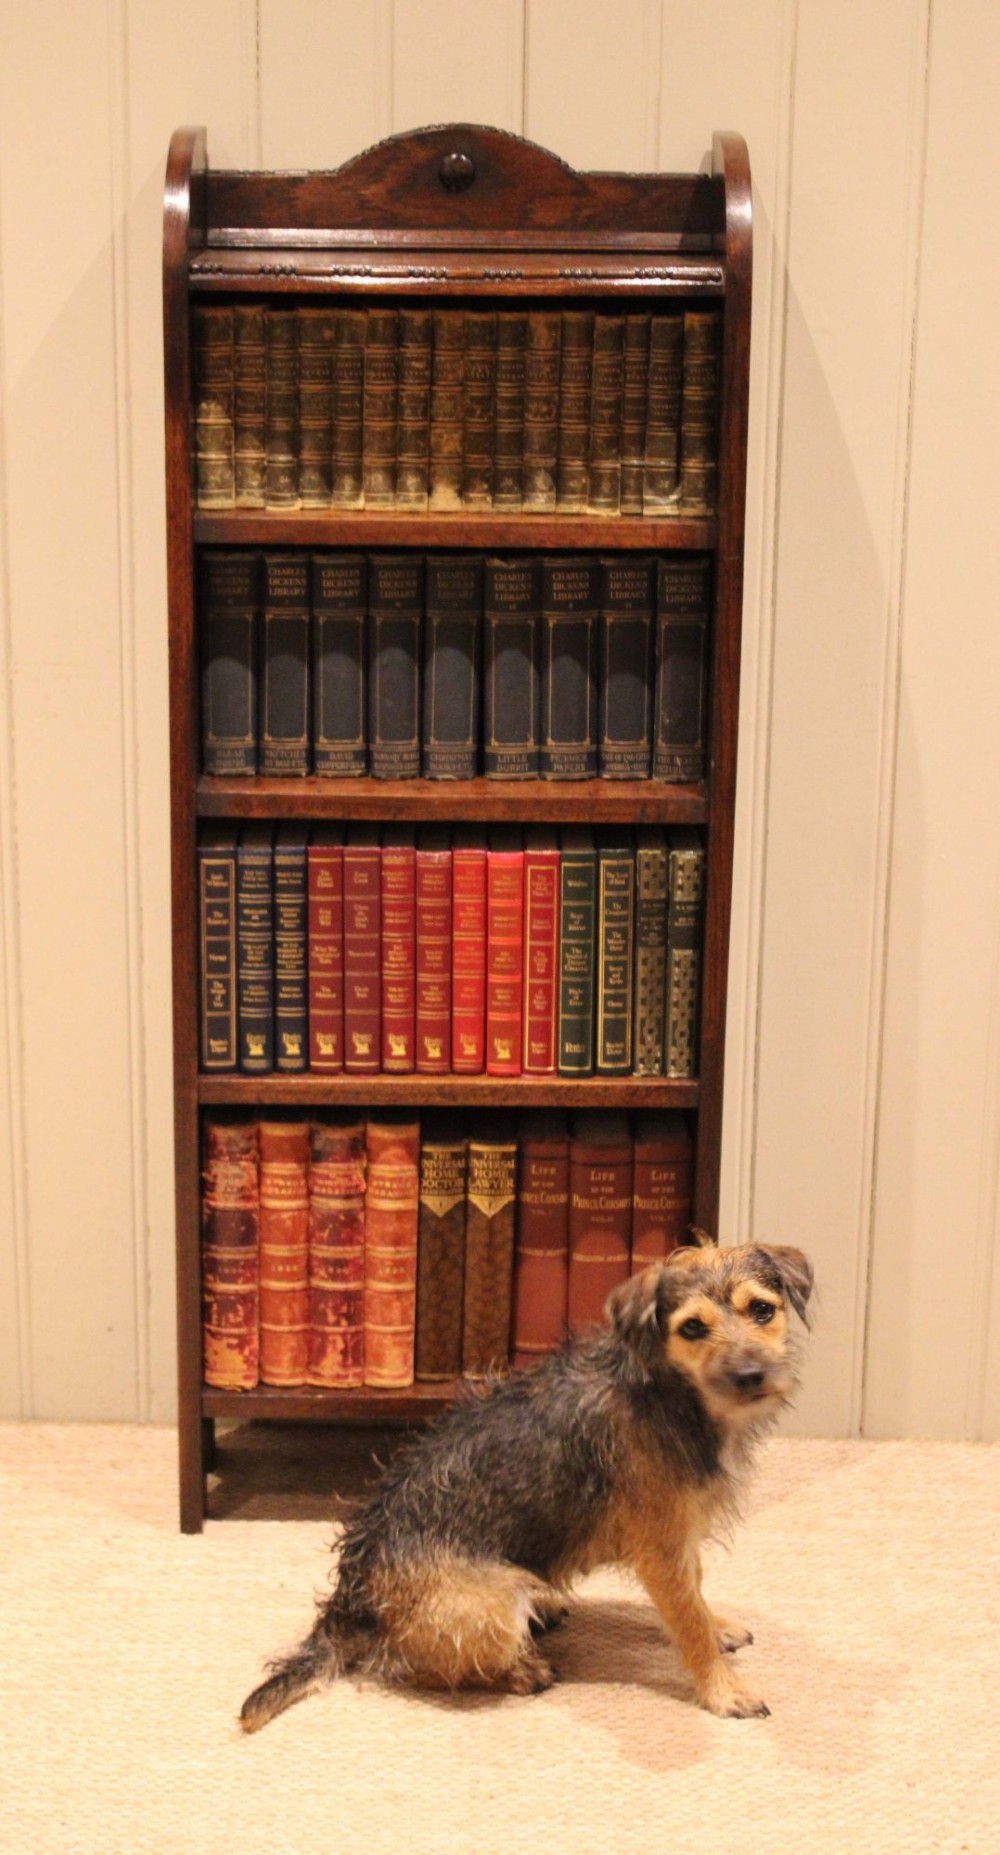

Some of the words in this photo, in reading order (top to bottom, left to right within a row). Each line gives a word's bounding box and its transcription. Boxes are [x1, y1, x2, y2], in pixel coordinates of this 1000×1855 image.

[268, 568, 306, 576] CHARLES
[321, 569, 360, 577] CHARLES
[493, 572, 532, 581] CHARLES
[552, 571, 590, 580] CHARLES
[609, 571, 648, 580] CHARLES
[269, 577, 306, 586] DICKENS
[322, 579, 361, 587] DICKENS
[552, 581, 590, 590] DICKENS
[609, 580, 648, 590] DICKENS
[494, 582, 532, 591] DICKENS
[269, 587, 304, 596] LIBRARY
[322, 589, 359, 598] LIBRARY
[553, 591, 588, 600] LIBRARY
[610, 590, 646, 599] LIBRARY
[495, 592, 531, 601] LIBRARY
[330, 752, 354, 761] DAVID
[497, 754, 528, 763] LITTLE
[496, 764, 528, 773] DORRIT
[553, 763, 586, 772] PAPERS
[434, 1152, 451, 1160] THE
[484, 1152, 501, 1160] THE
[421, 1160, 465, 1168] NIVERSAL
[424, 1169, 459, 1178] HOME
[474, 1169, 508, 1178] HOME
[421, 1179, 464, 1188] DOCTOR
[468, 1178, 513, 1189] LAWYER
